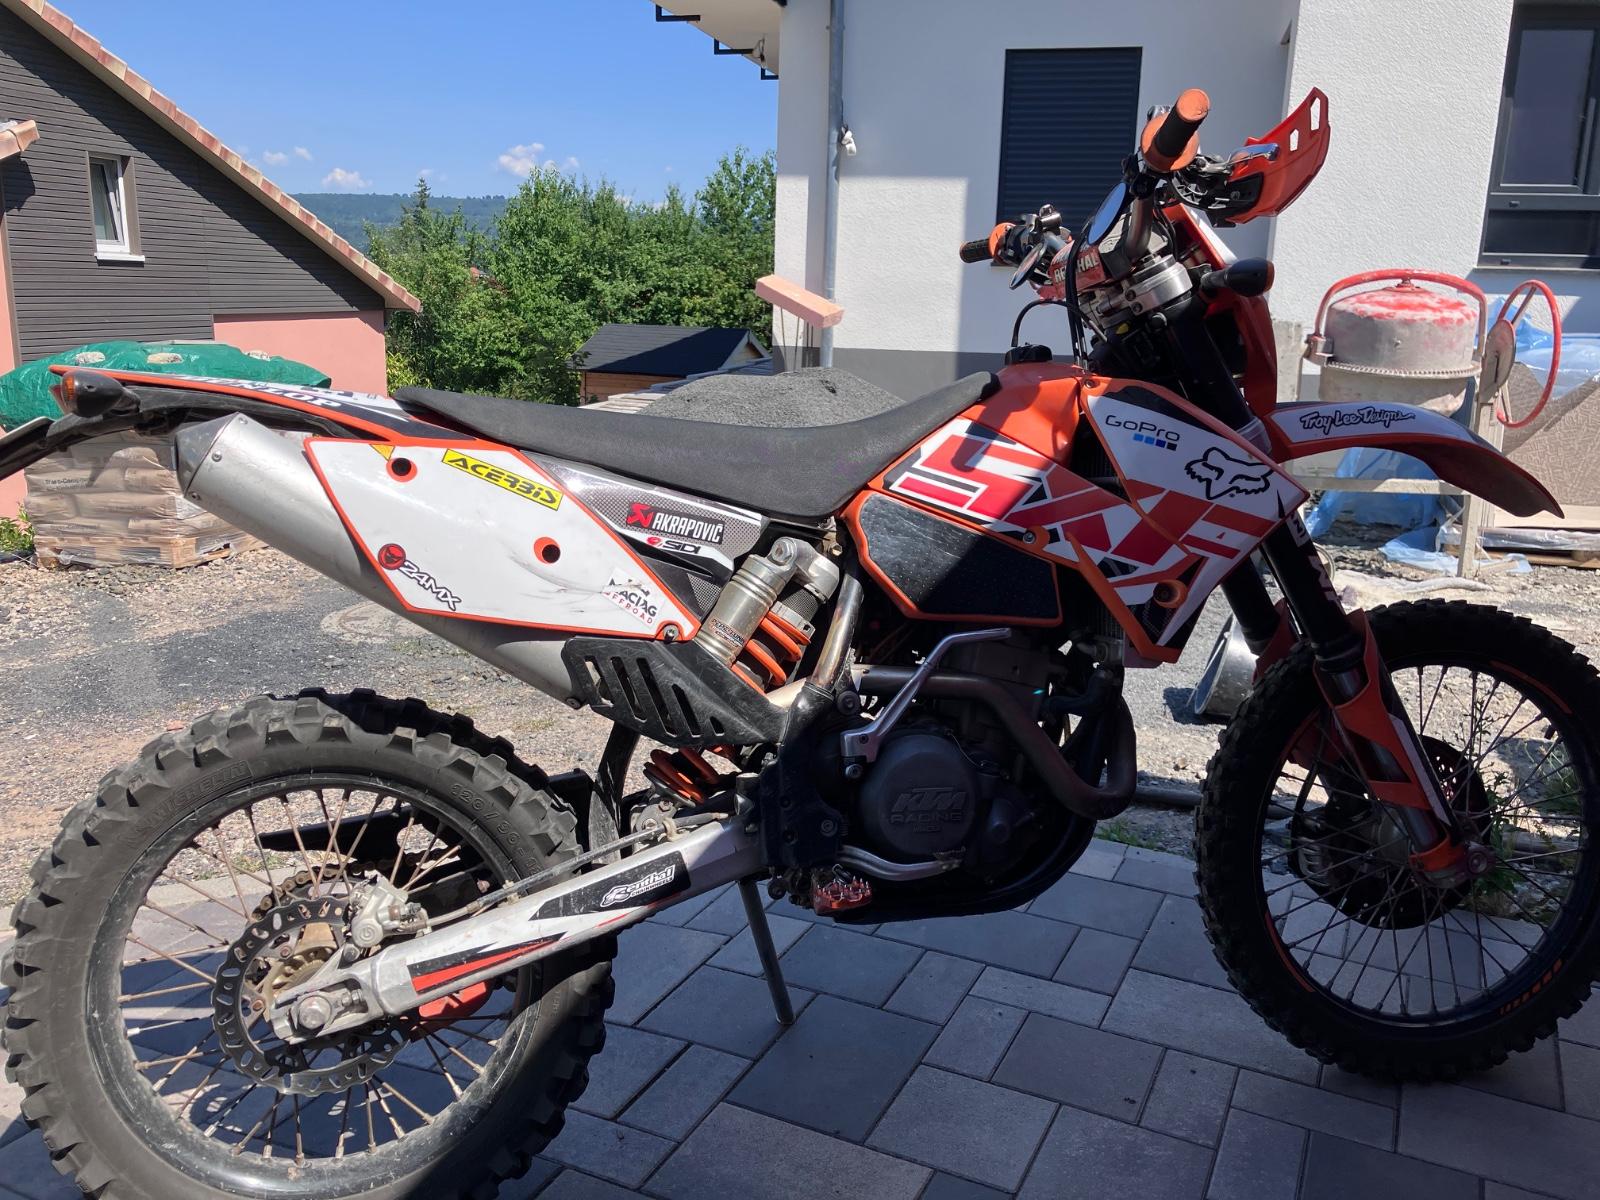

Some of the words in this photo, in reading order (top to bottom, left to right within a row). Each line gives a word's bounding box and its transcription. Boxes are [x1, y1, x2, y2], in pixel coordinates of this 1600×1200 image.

[1054, 249, 1100, 283] REHAL
[1105, 414, 1181, 442] GoPro
[1300, 411, 1333, 435] Troy
[1333, 410, 1360, 427] Lee
[398, 560, 462, 611] 24MX
[890, 787, 967, 812] KTM
[889, 812, 963, 824] RACING
